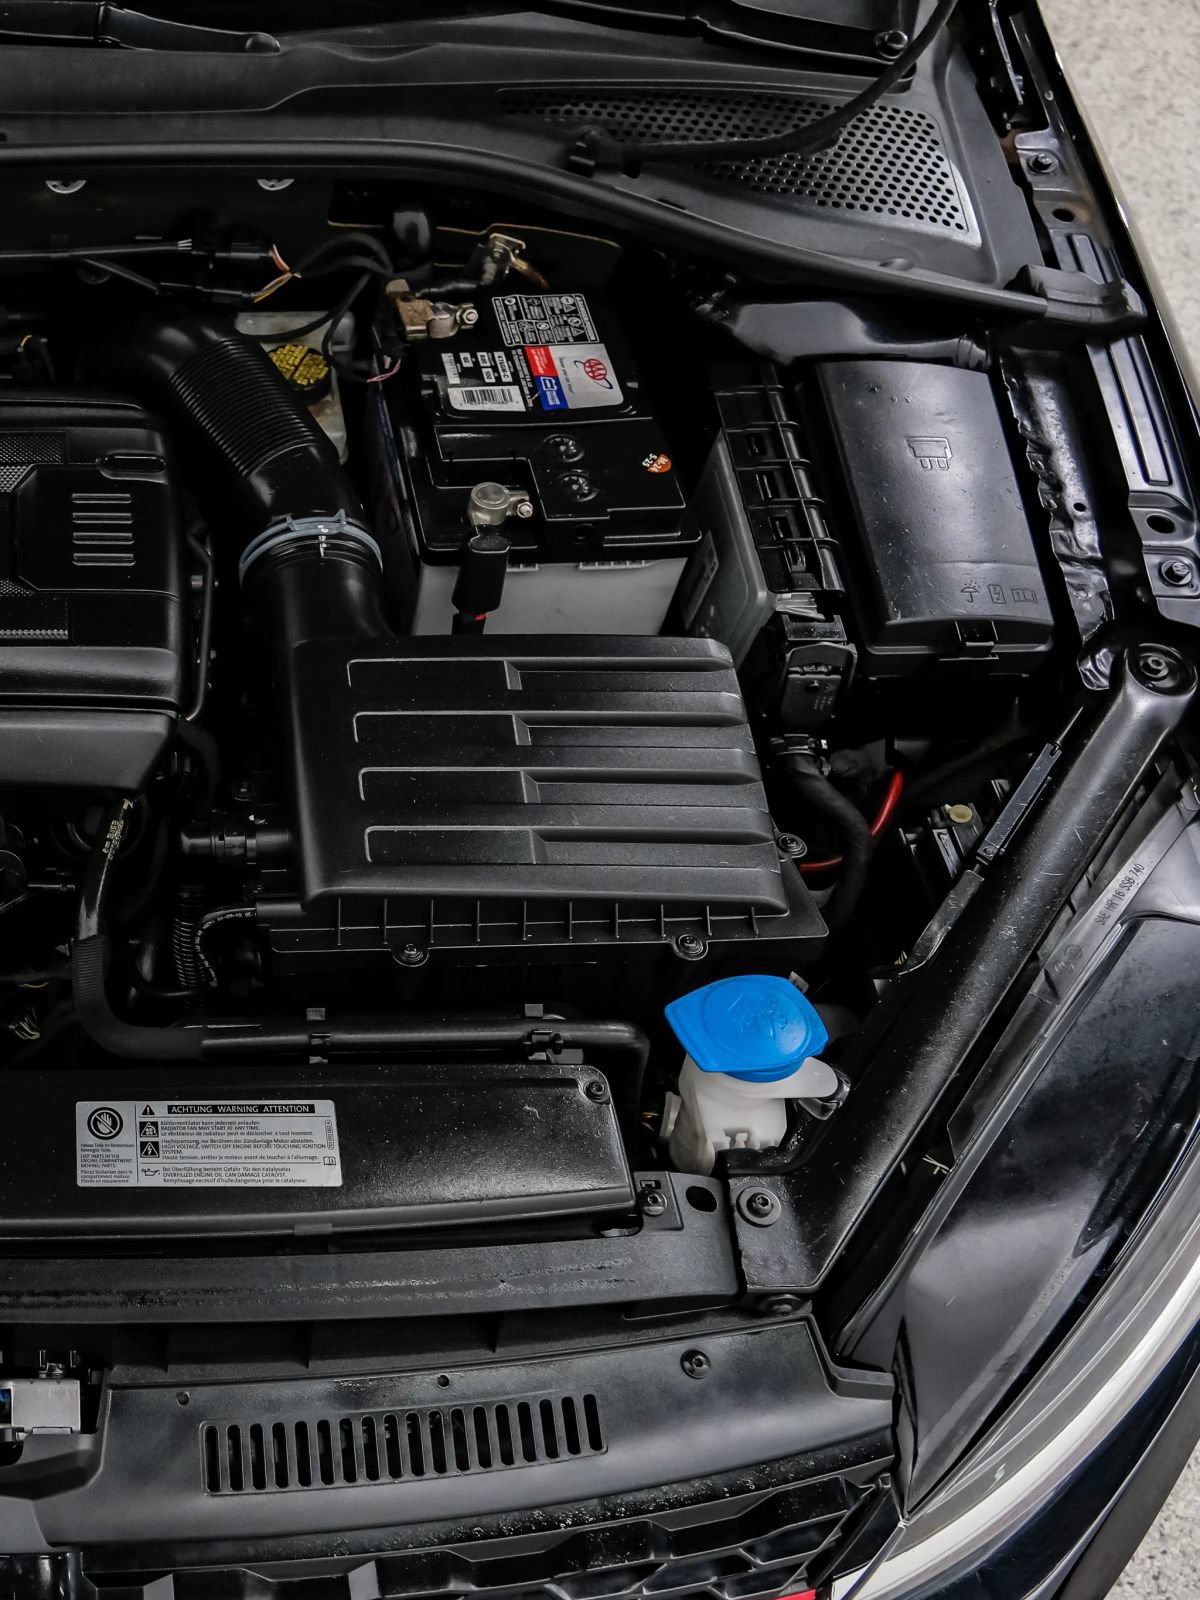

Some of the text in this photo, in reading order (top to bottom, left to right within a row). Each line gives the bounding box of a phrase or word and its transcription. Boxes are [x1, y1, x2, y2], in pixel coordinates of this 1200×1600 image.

[584, 359, 607, 381] AAA
[642, 453, 658, 468] 5-25
[1095, 863, 1145, 926] SAE HR 16 SSB 740
